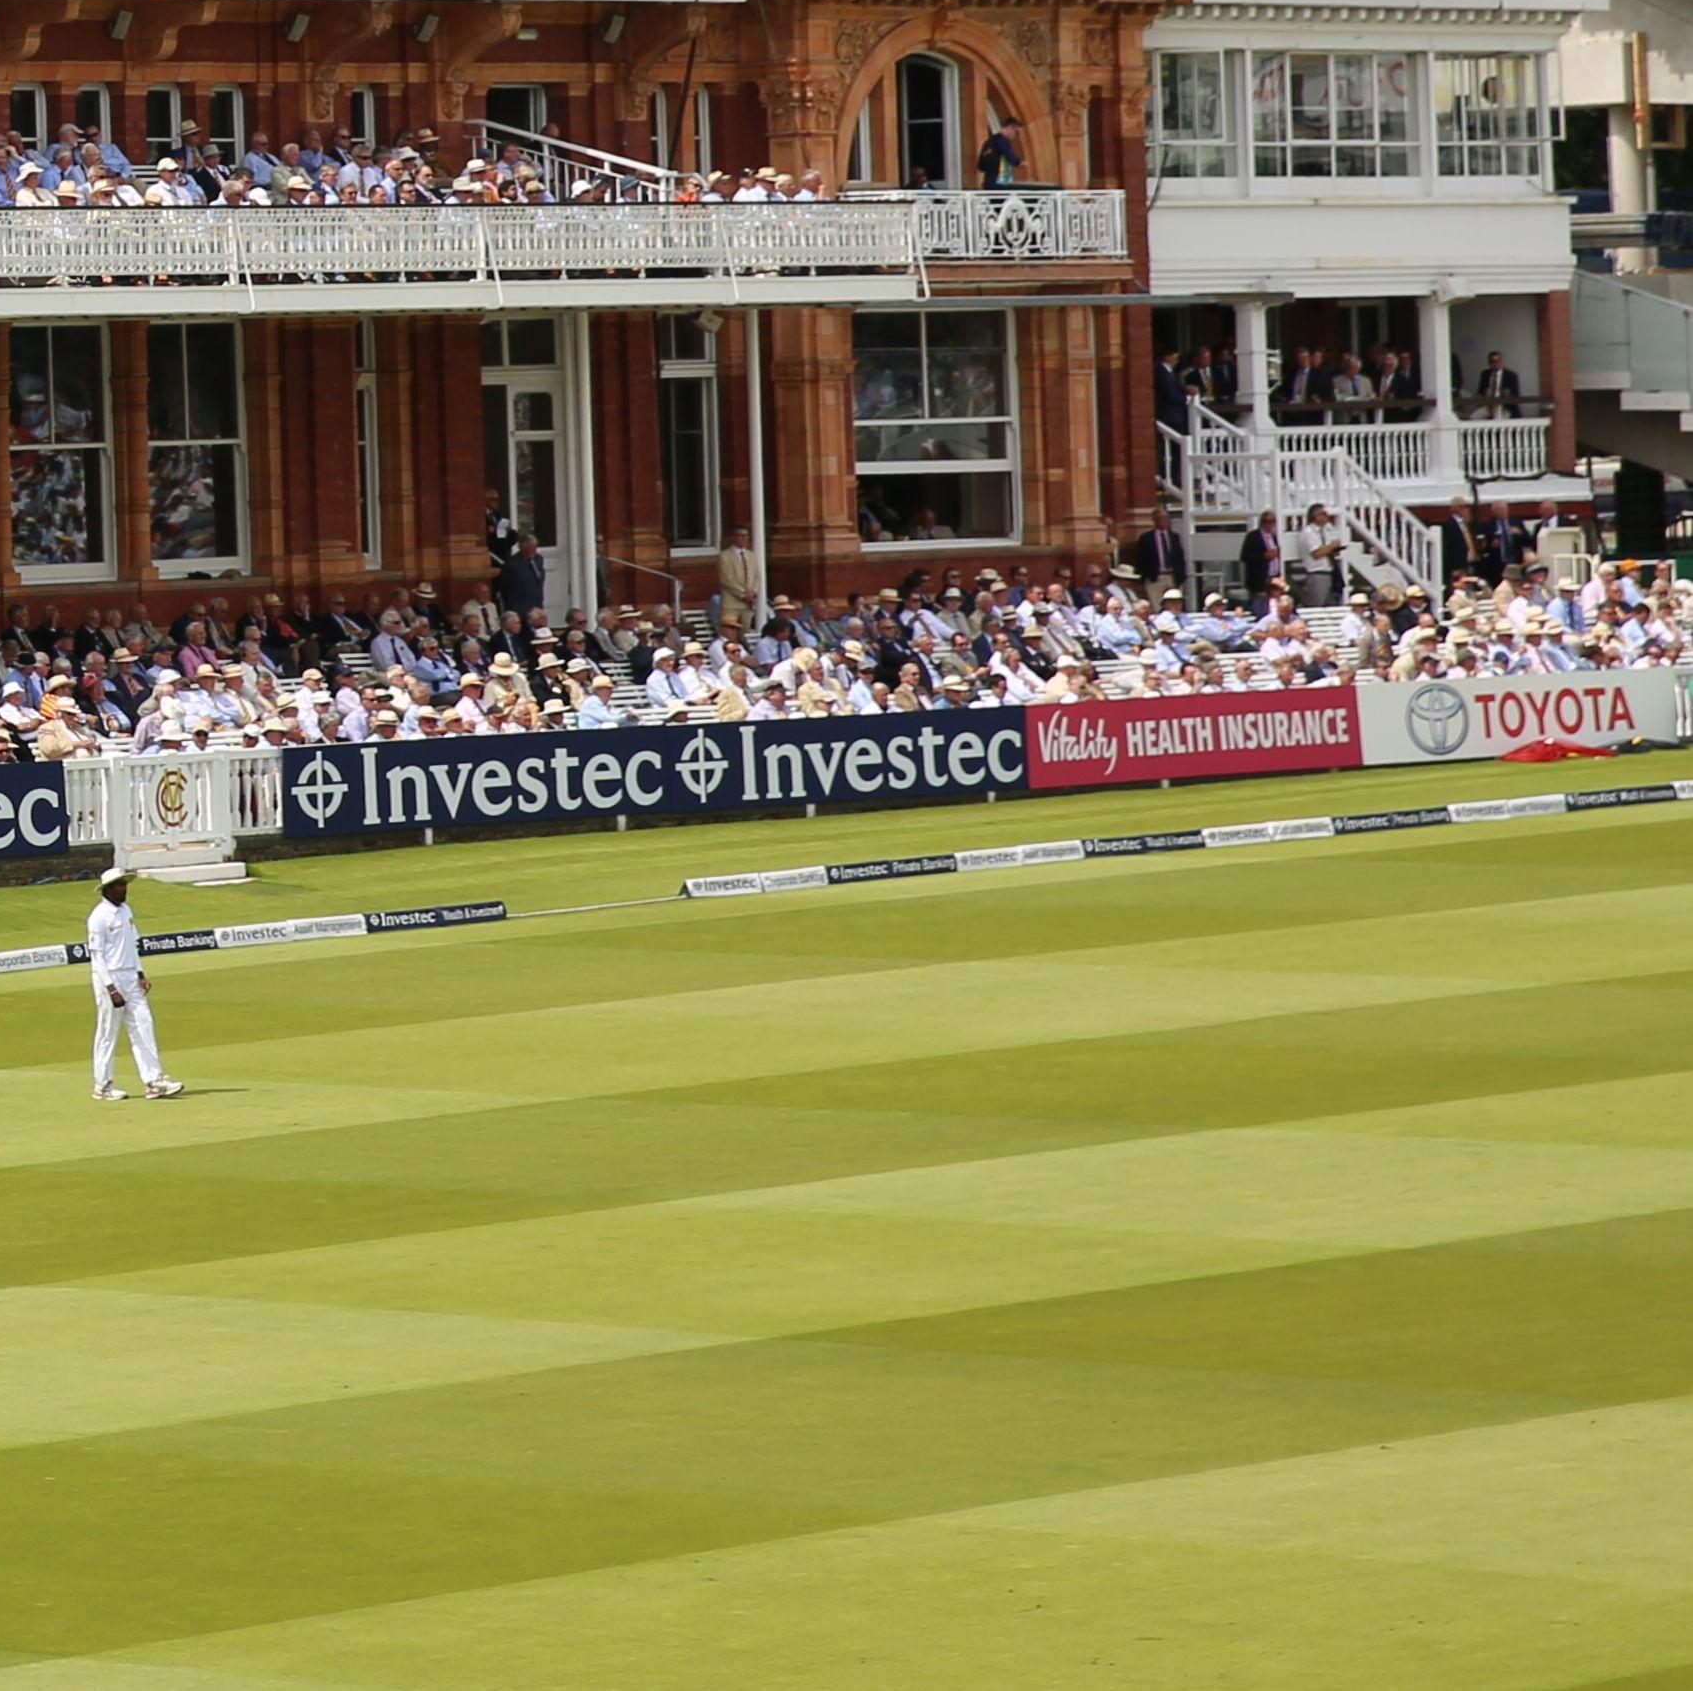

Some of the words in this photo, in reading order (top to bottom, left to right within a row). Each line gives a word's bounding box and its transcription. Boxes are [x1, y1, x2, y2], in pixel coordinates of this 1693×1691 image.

[1475, 685, 1636, 739] TOYOTA
[1037, 709, 1119, 776] Vitality
[1125, 715, 1215, 757] HEALTH
[1217, 707, 1351, 751] INSURANCE
[739, 724, 1024, 802] Investec
[361, 745, 663, 826] Investec
[839, 863, 889, 879] Investec
[704, 878, 757, 893] Investec
[380, 911, 436, 927] Investec
[143, 934, 176, 951] Private
[177, 932, 215, 950] Banking
[231, 925, 287, 942] Investec
